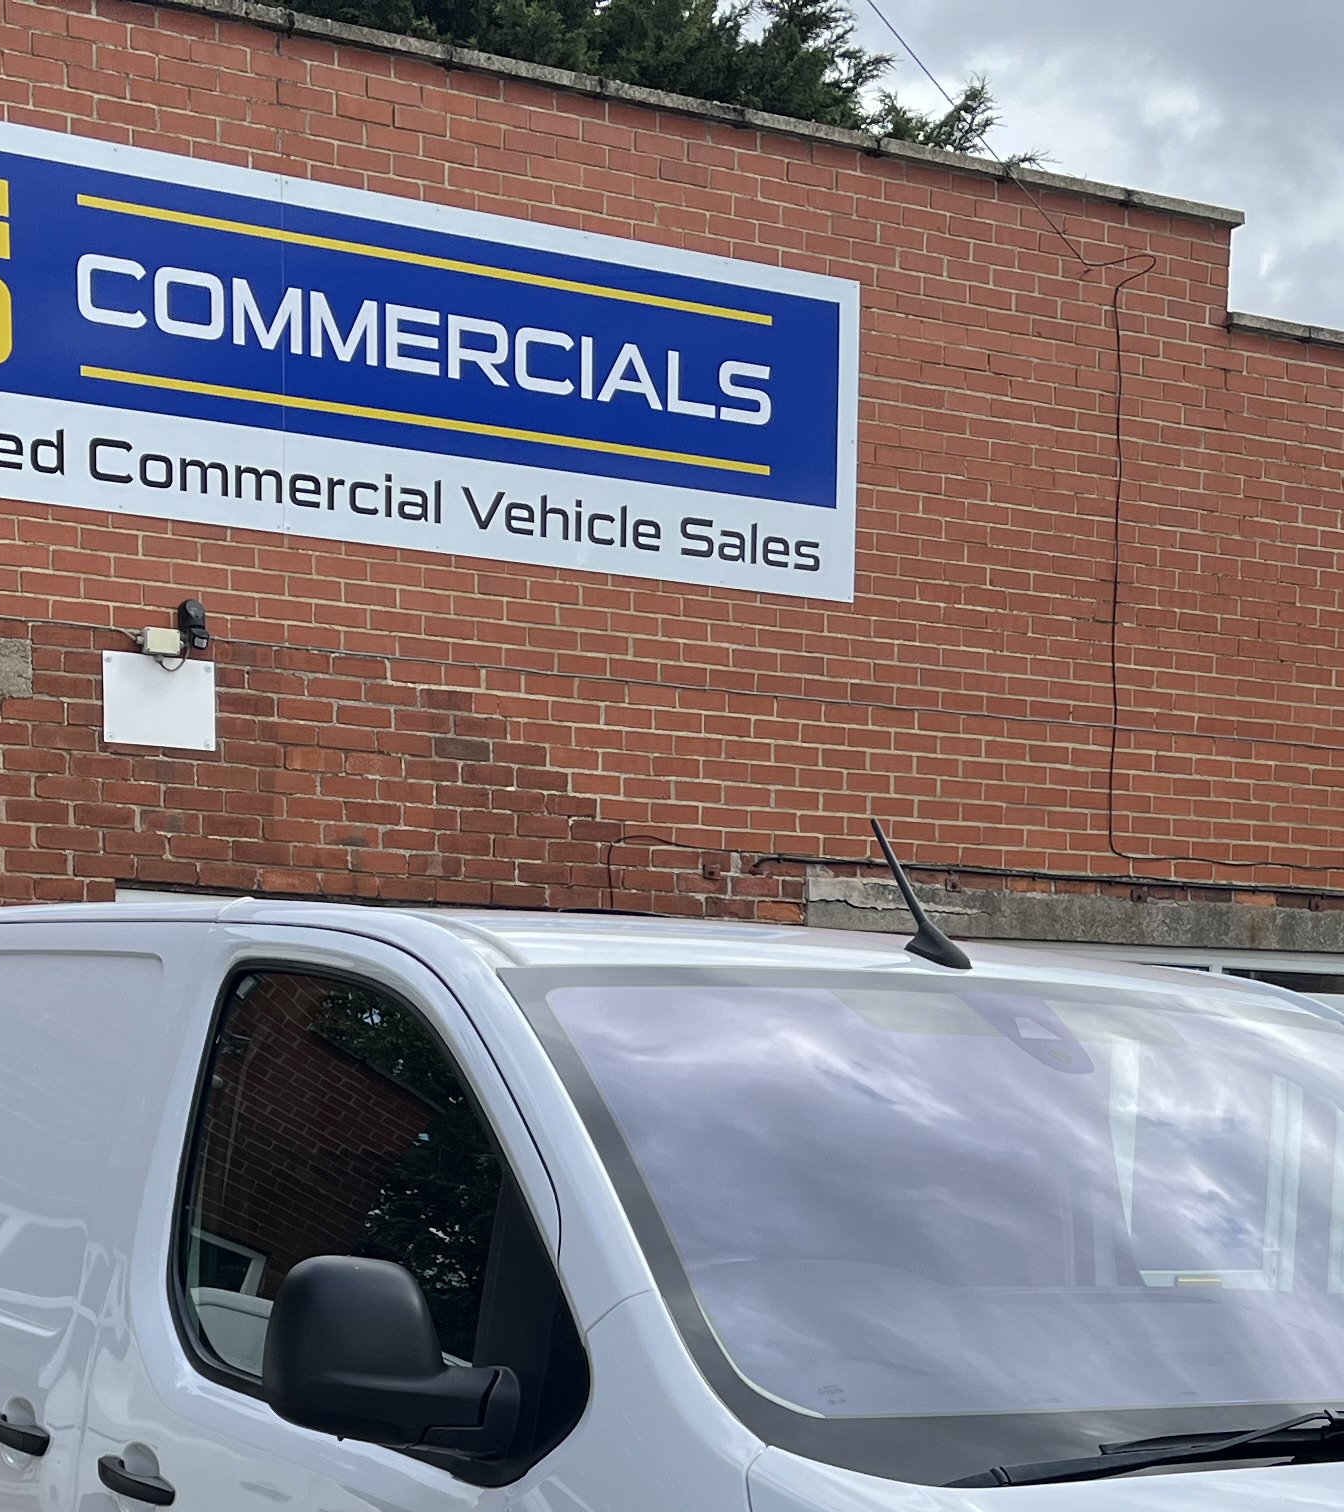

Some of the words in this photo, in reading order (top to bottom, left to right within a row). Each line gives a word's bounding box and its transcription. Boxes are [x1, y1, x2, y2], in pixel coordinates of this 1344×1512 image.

[77, 253, 773, 426] COMMERCIALS
[88, 437, 443, 525] Commercial
[462, 486, 661, 552] Vehicle
[680, 517, 821, 573] Sales
